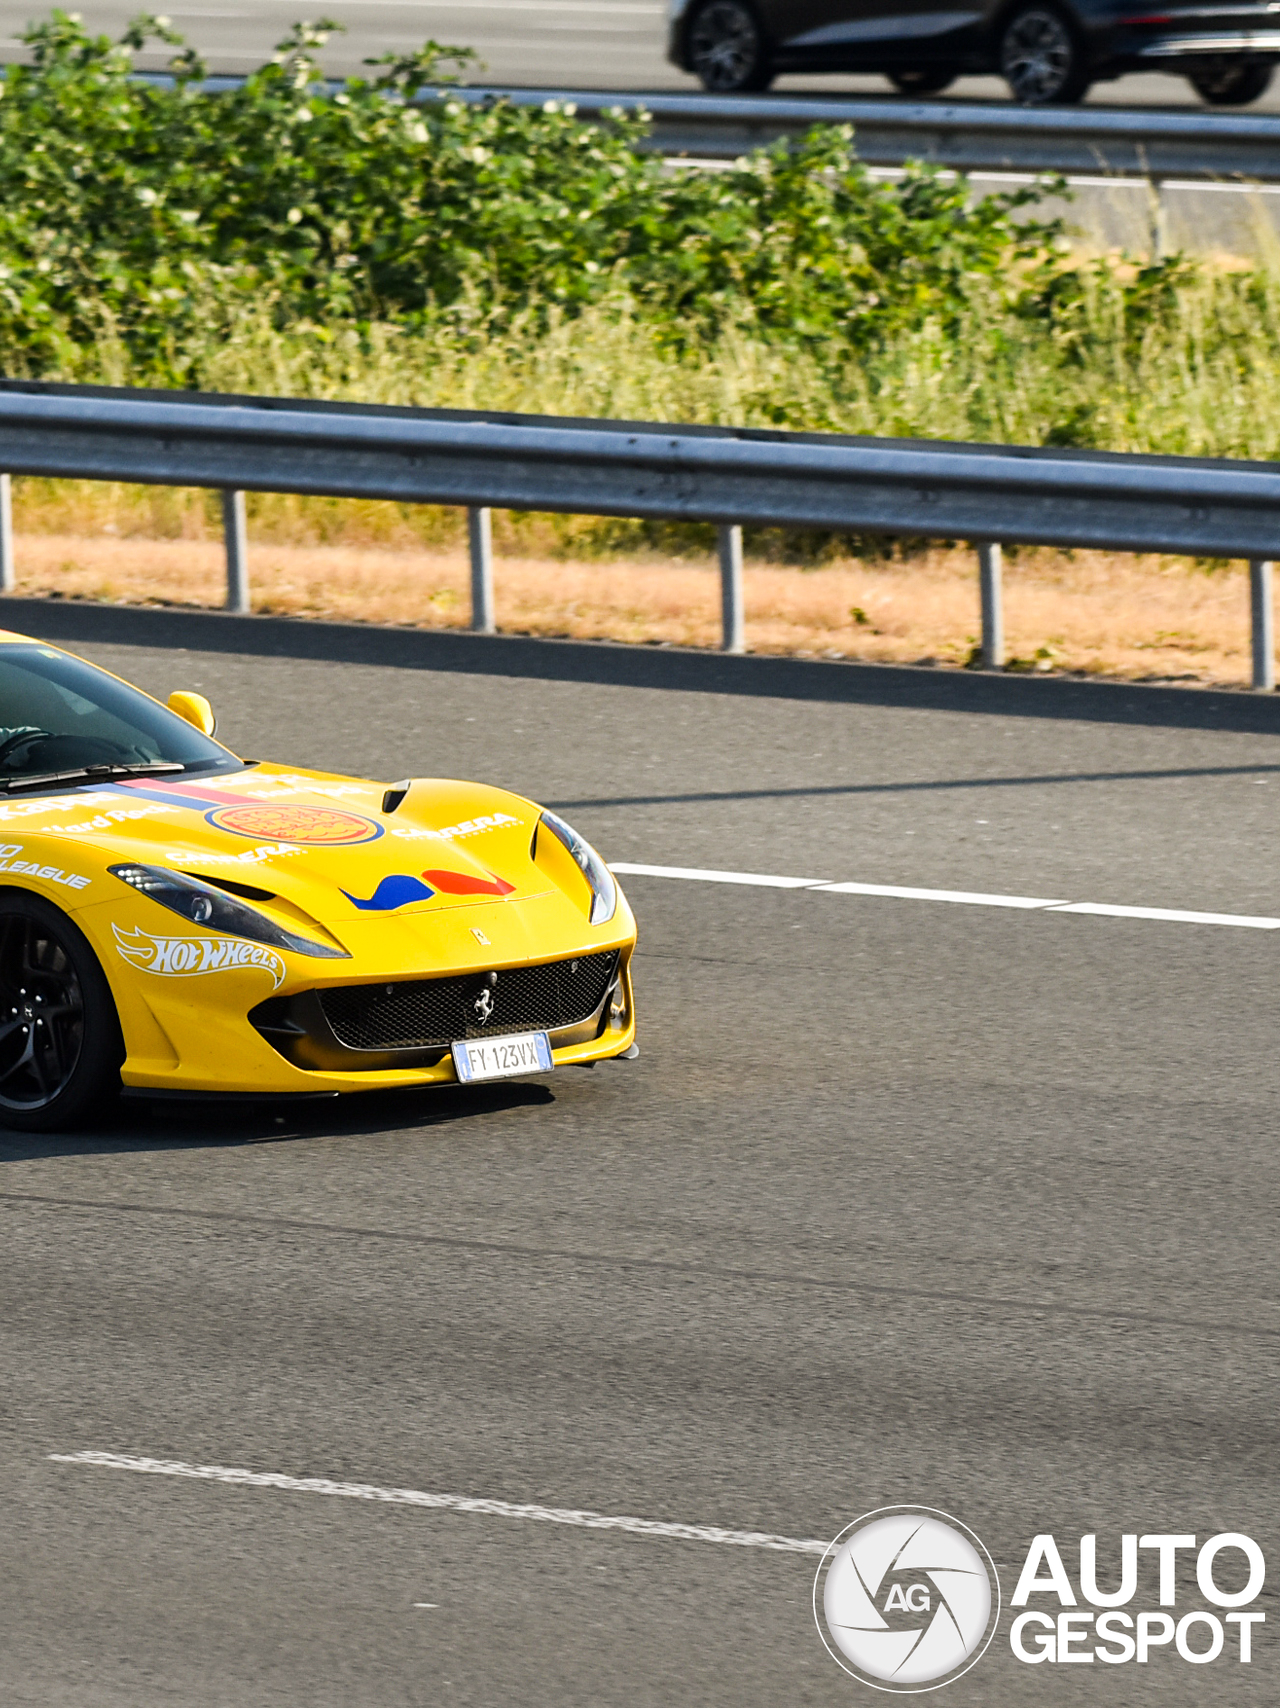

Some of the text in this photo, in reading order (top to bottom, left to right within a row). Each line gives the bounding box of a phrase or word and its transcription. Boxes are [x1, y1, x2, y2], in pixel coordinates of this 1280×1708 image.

[106, 804, 182, 822] Rock
[391, 812, 518, 839] CARRERA
[165, 842, 302, 863] CARRERA
[468, 1041, 538, 1072] FY 123VX
